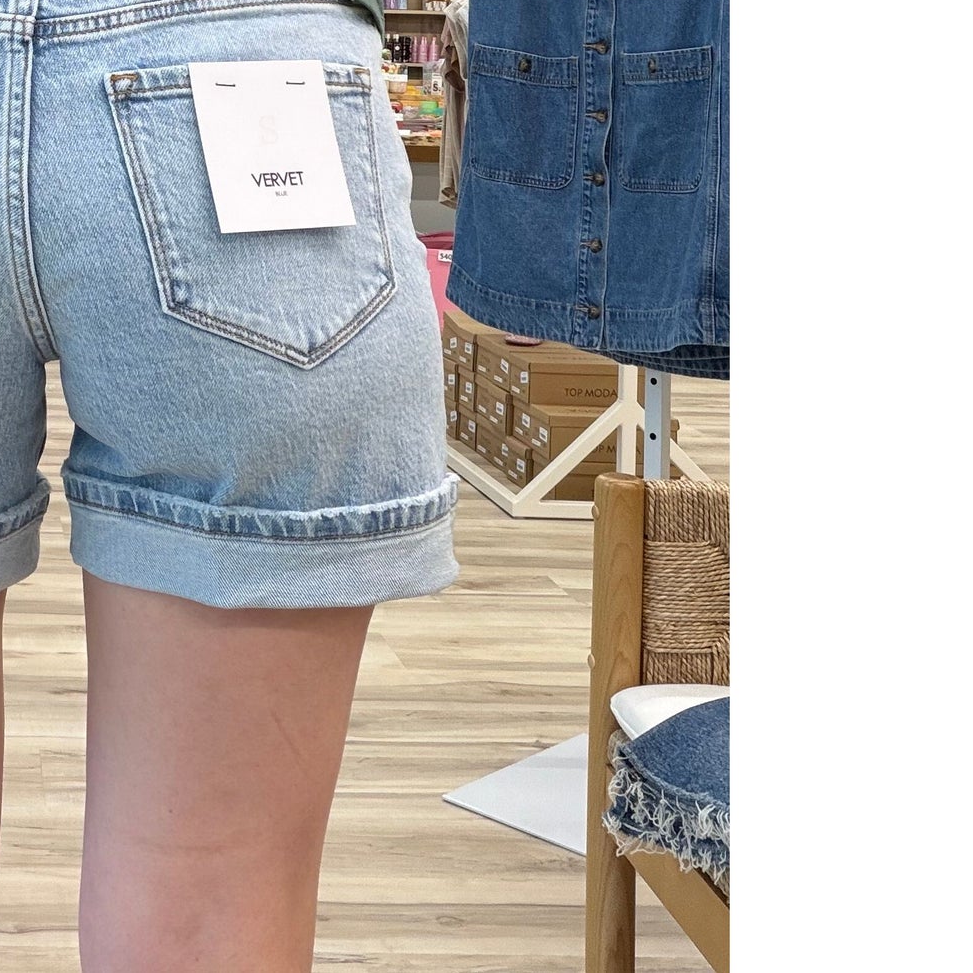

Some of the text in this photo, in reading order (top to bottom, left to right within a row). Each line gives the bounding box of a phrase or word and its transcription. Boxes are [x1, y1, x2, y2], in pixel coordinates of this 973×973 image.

[251, 171, 304, 187] VERVET
[564, 387, 618, 398] TOP MODA
